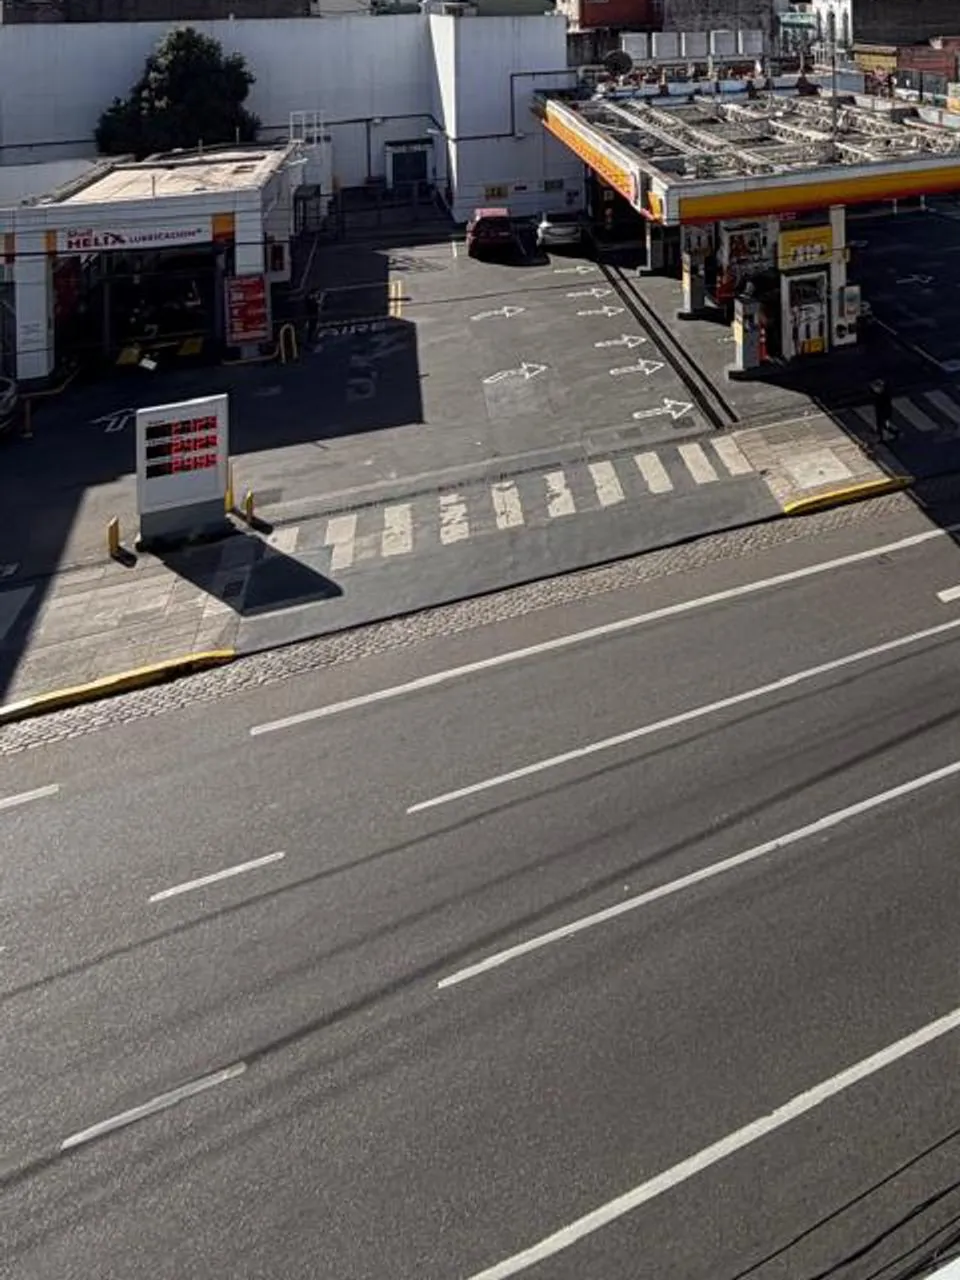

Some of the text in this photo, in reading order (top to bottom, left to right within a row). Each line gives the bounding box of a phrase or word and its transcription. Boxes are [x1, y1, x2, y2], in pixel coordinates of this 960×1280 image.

[67, 228, 93, 238] Shell
[67, 232, 126, 249] HELIX
[319, 322, 386, 338] AIRE
